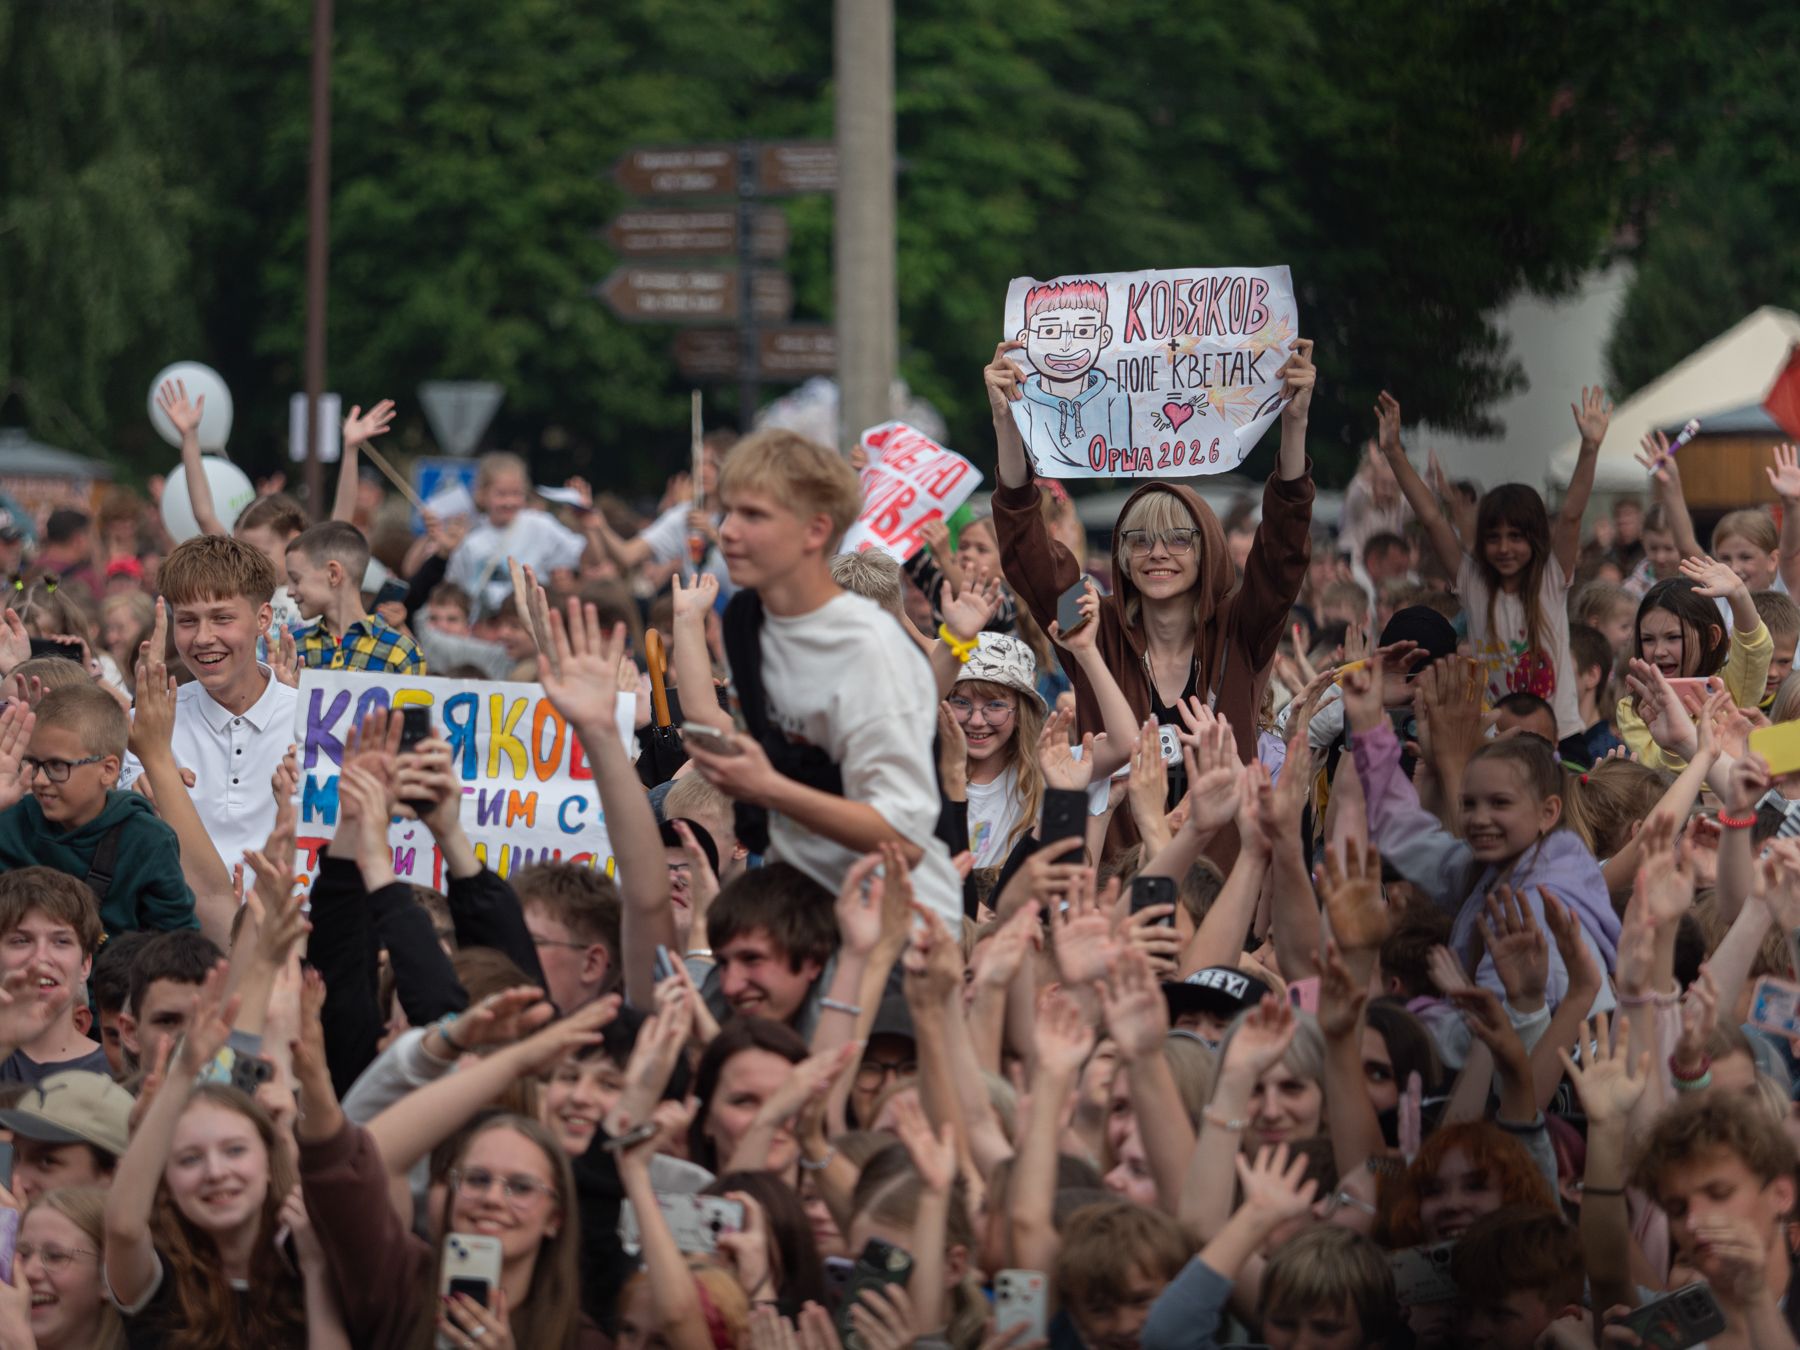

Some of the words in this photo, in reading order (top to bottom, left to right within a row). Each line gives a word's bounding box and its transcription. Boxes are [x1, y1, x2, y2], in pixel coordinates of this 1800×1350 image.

[1124, 276, 1269, 344] КОБЯКОВ
[1116, 355, 1162, 393] ПОЛЕ
[1172, 350, 1266, 390] КВЕТАК
[1157, 437, 1220, 470] 2026
